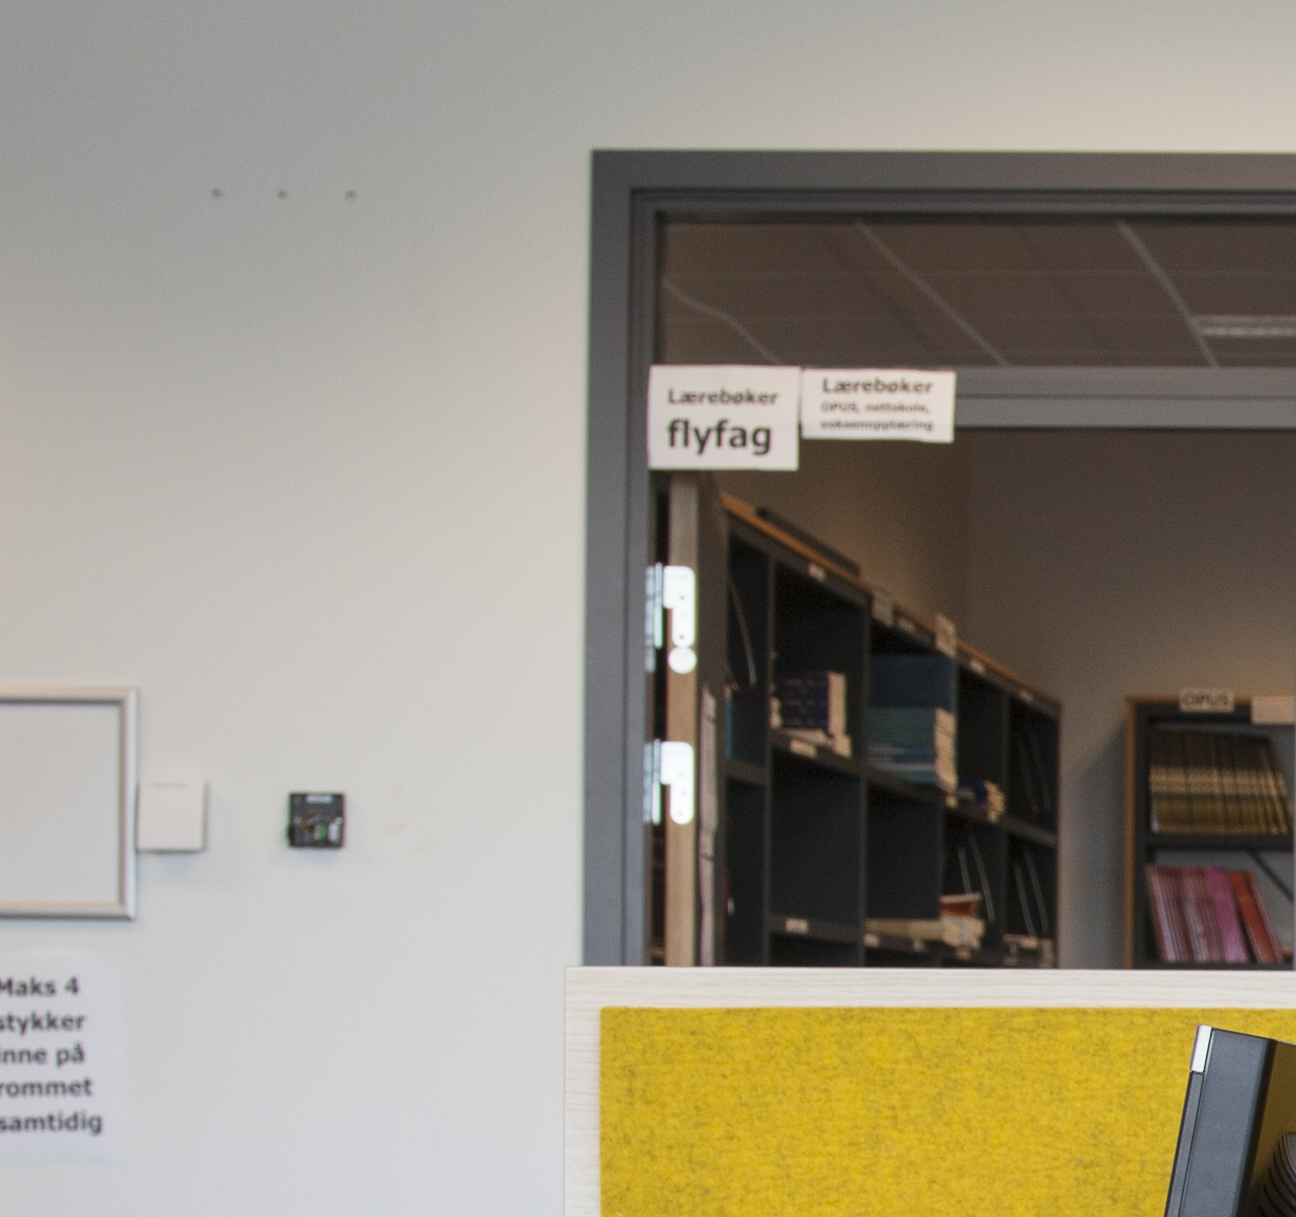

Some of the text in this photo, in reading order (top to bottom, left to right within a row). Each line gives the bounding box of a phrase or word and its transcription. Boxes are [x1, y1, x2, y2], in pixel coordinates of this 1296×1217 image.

[822, 377, 933, 394] Lærebøker
[668, 387, 779, 405] Lærebøker
[668, 418, 771, 456] flyfag
[65, 976, 79, 995] 4
[56, 1041, 85, 1069] på
